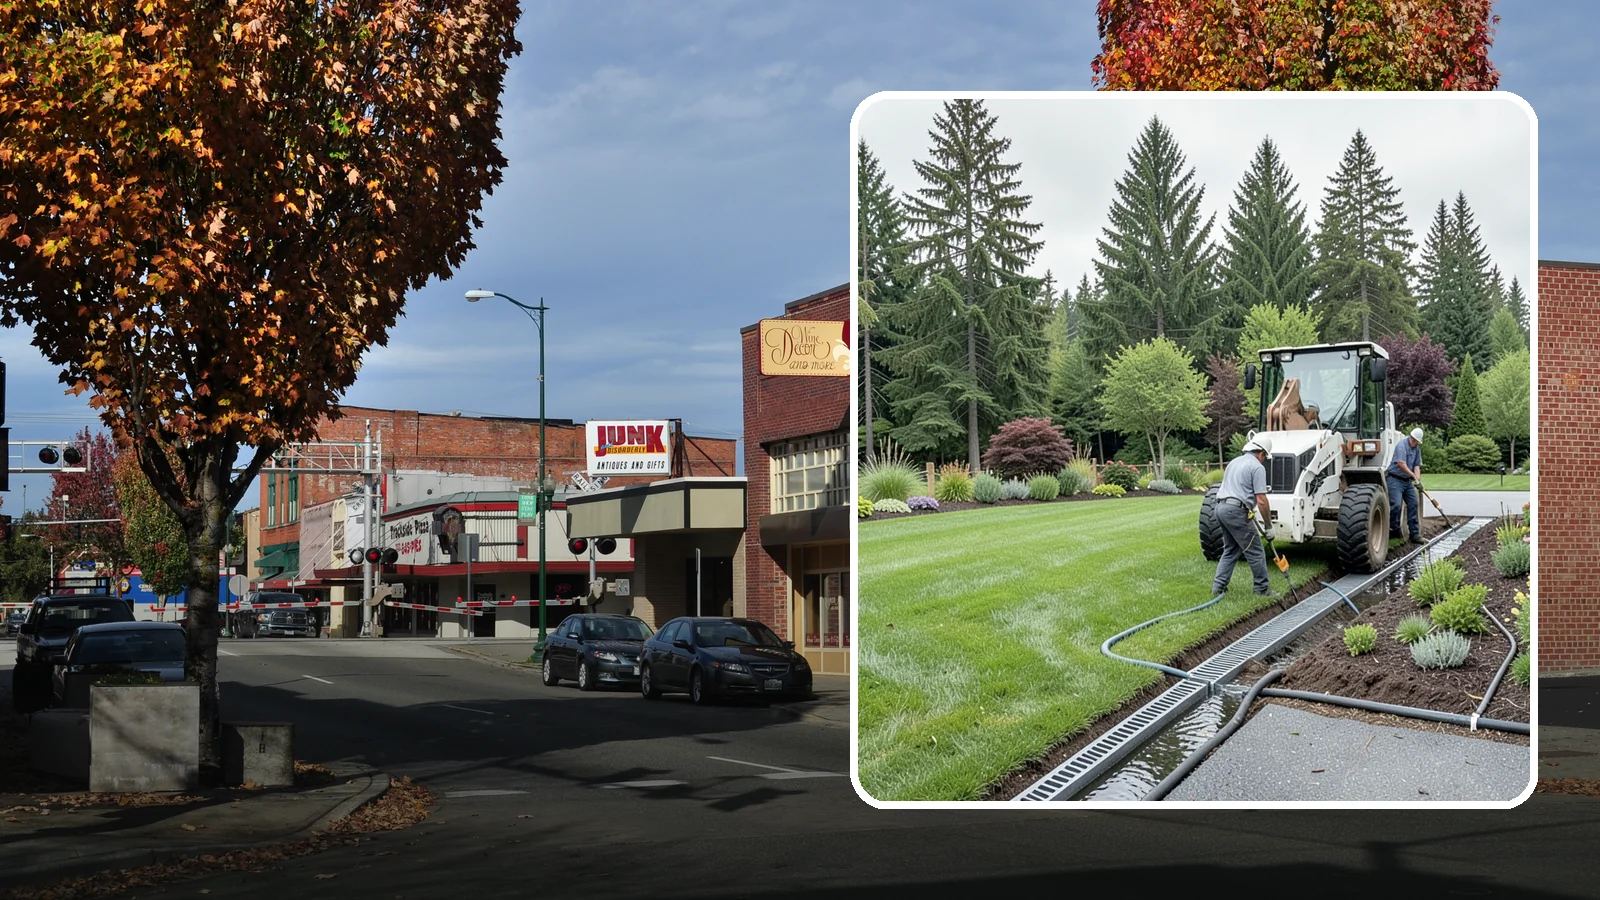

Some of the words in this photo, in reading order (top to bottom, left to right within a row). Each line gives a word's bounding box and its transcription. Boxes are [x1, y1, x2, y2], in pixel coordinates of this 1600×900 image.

[595, 425, 665, 457] JUNK
[607, 446, 646, 454] DISORDERLY
[597, 461, 628, 470] ANTIQUES
[631, 461, 644, 470] AND
[647, 460, 665, 470] GIFTS
[414, 520, 429, 535] Pizza
